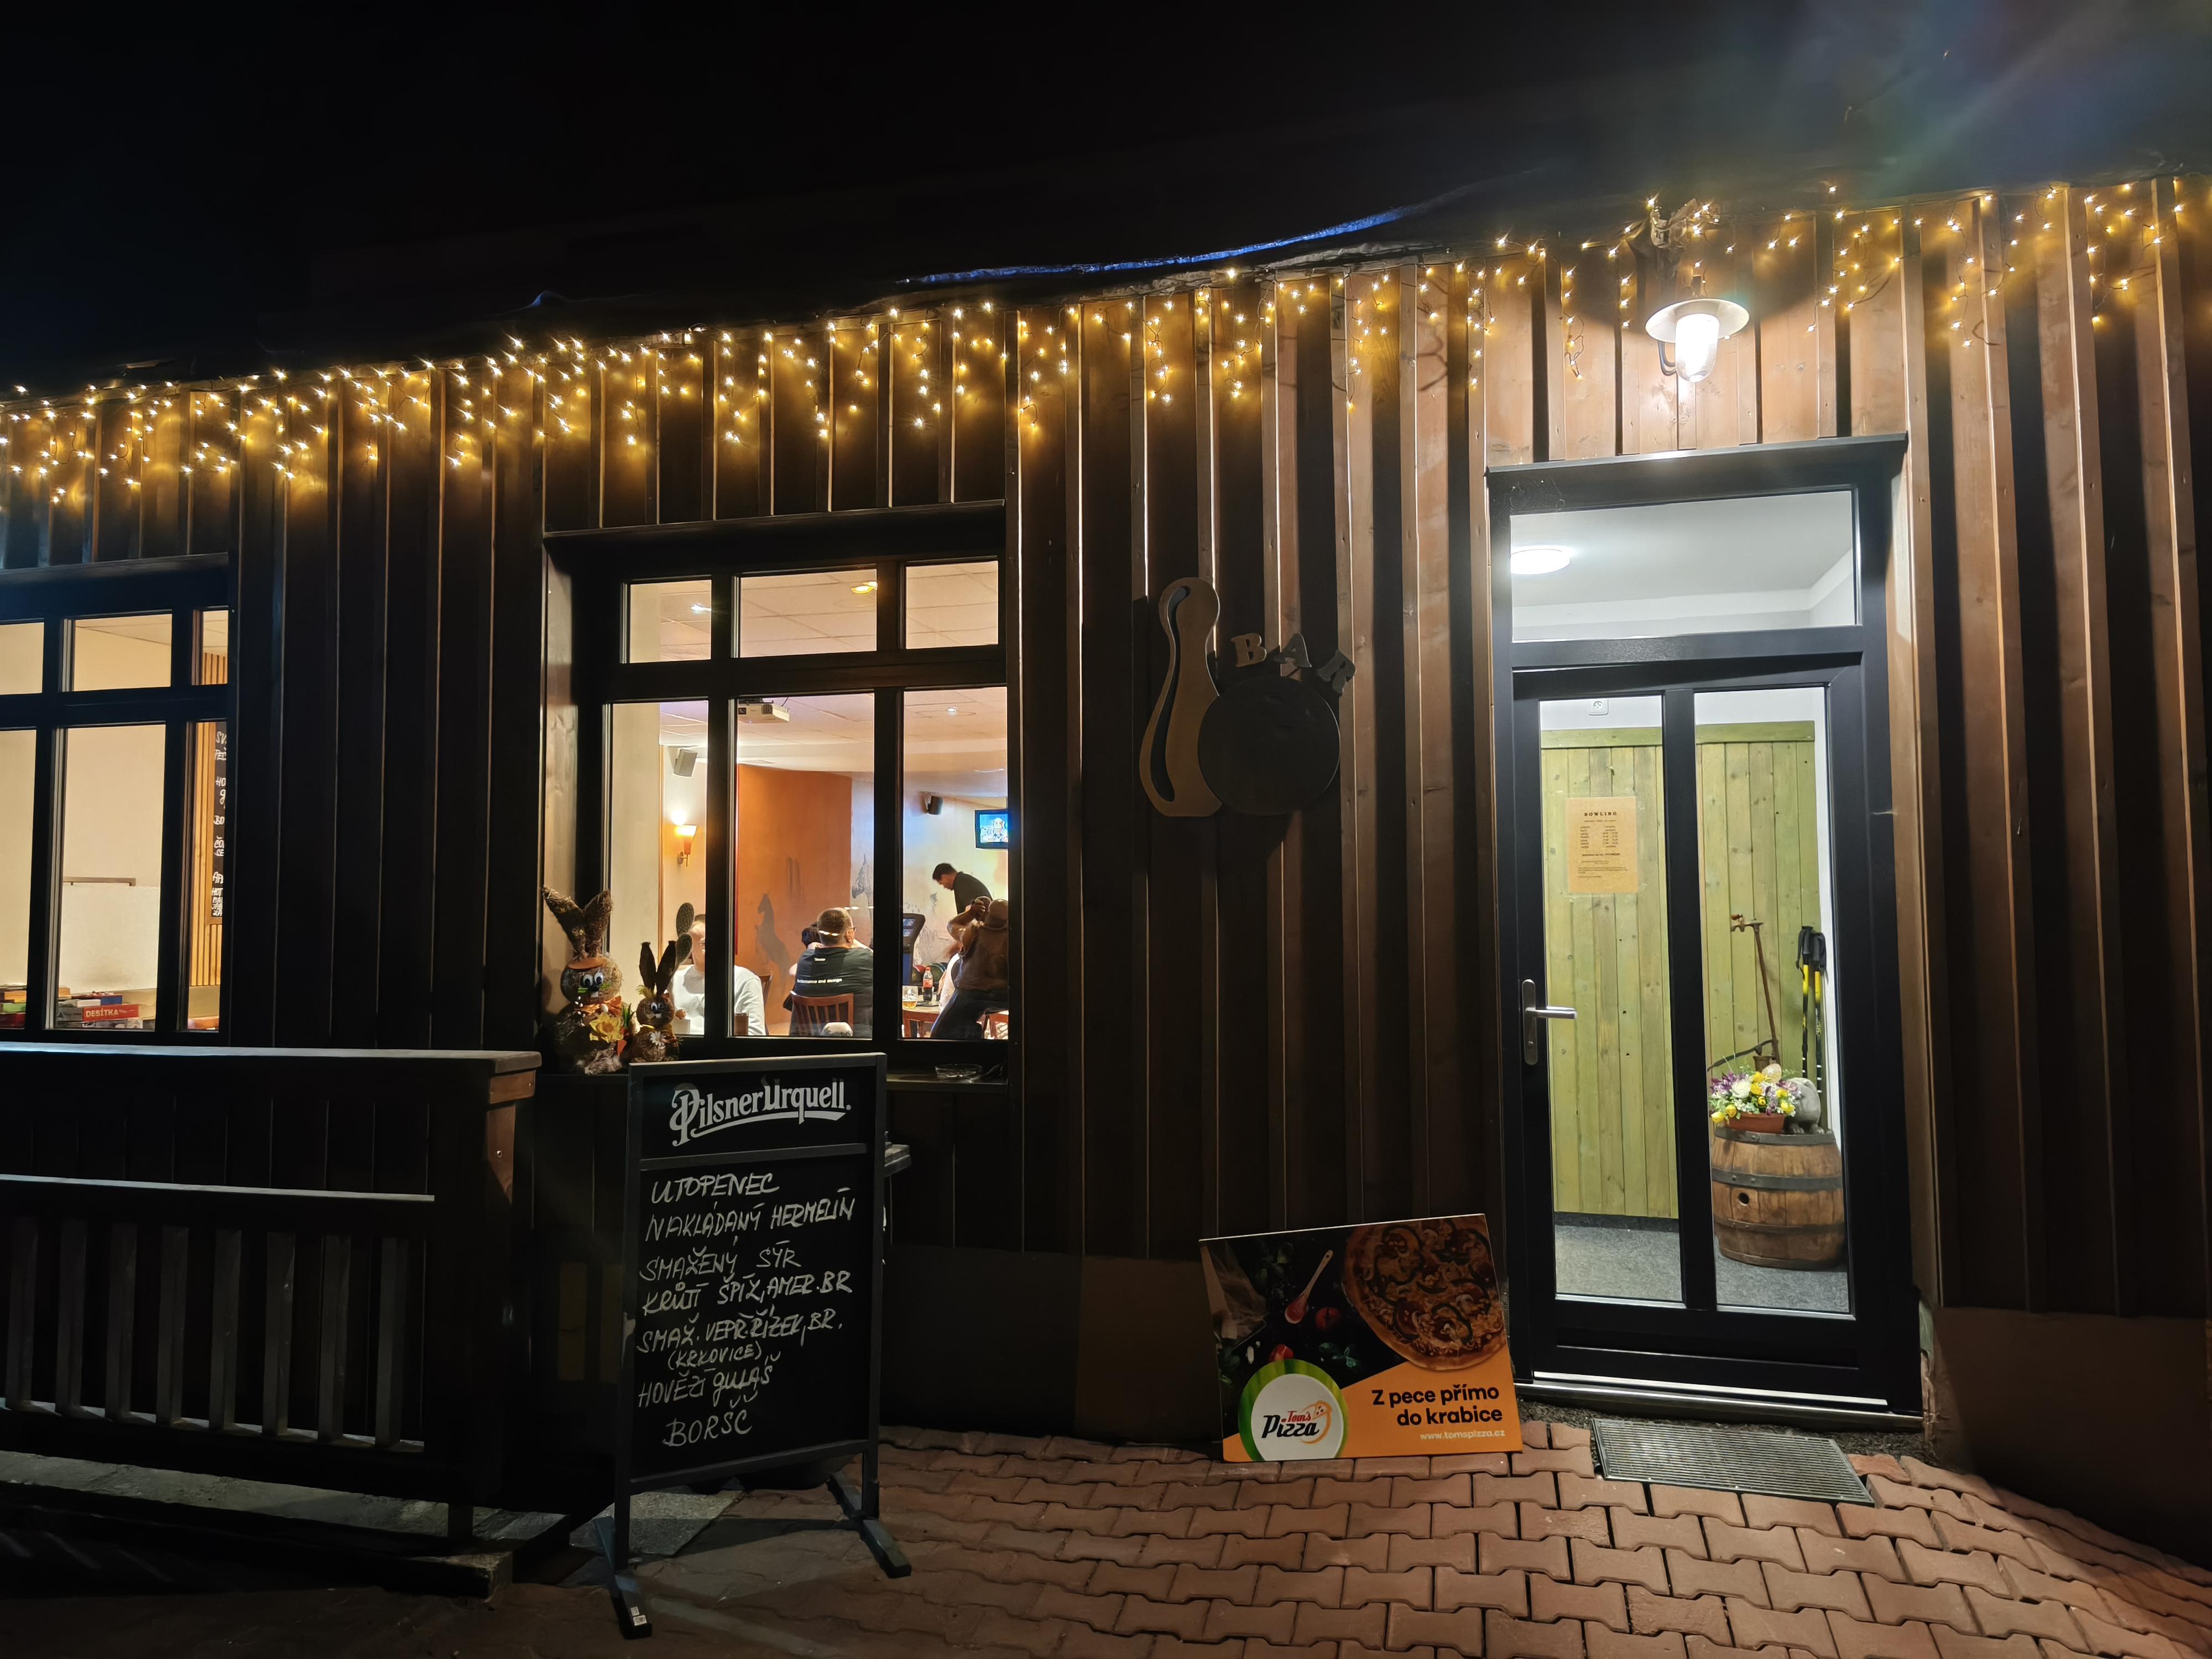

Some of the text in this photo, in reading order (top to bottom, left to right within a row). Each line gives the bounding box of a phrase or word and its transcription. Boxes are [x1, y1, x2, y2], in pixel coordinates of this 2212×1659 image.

[1230, 633, 1356, 695] BAR
[670, 1078, 846, 1146] Pilsner Urquell
[651, 1172, 780, 1204] UTOPENEC
[645, 1187, 855, 1242] NAKLÁDANÝ HERMELÍN
[639, 1235, 802, 1281] SMAŽENÝ SÝR
[1371, 1384, 1500, 1408] Z pece přímo
[1396, 1405, 1503, 1426] do krabice
[1261, 1414, 1320, 1438] Pizza
